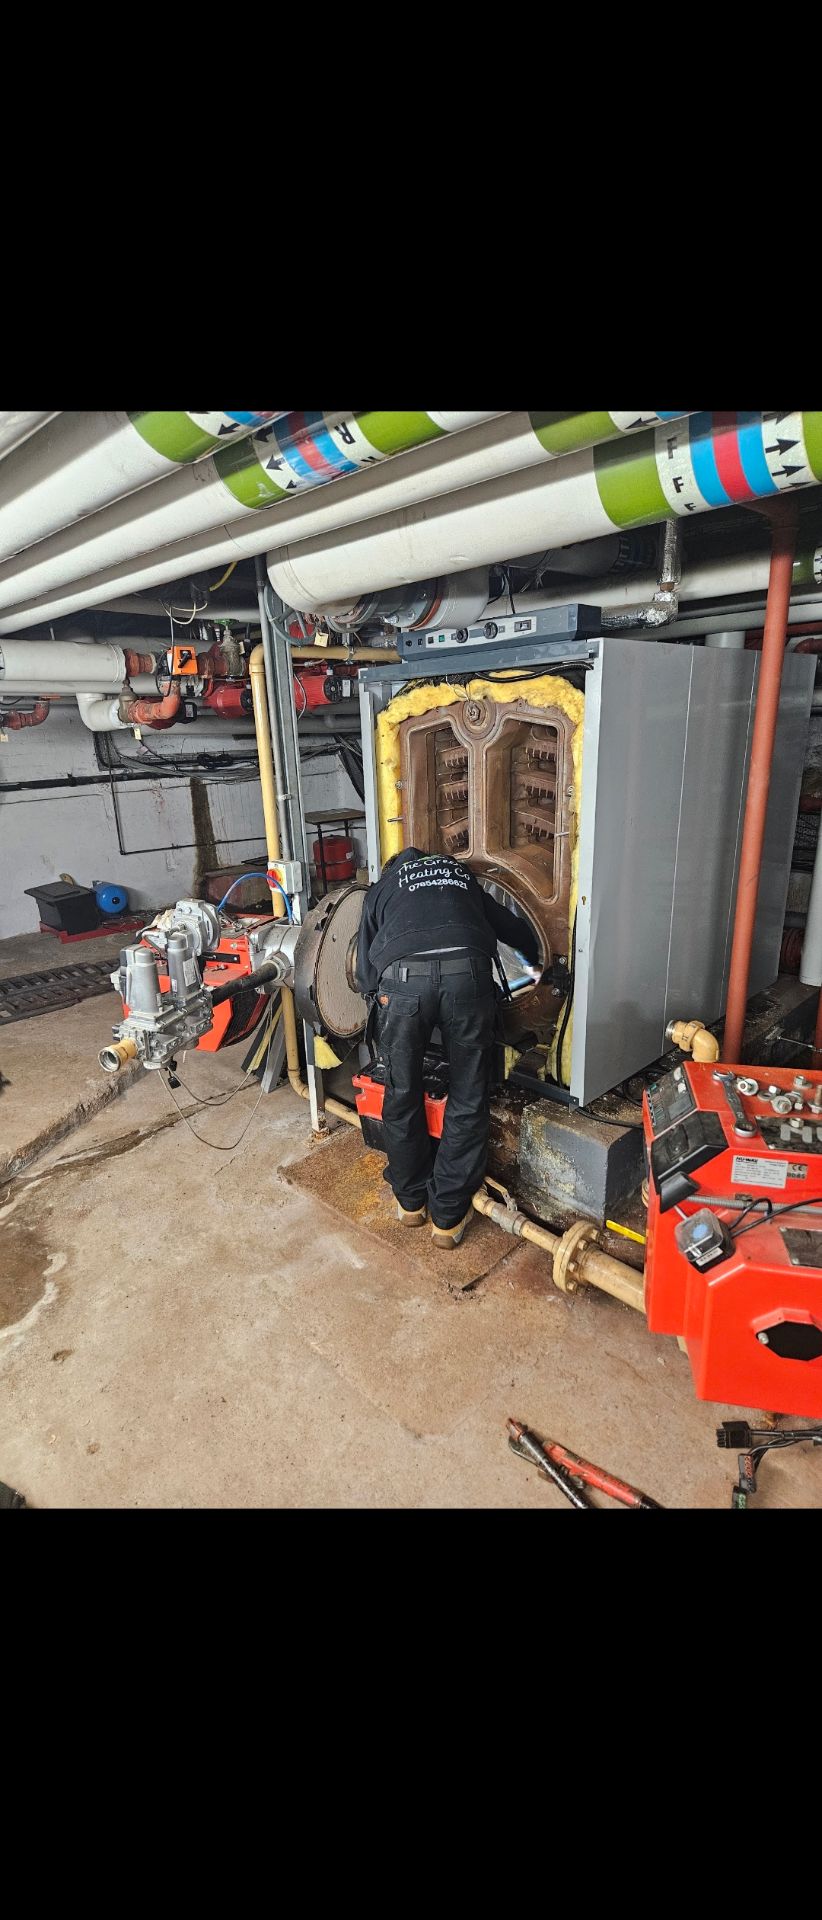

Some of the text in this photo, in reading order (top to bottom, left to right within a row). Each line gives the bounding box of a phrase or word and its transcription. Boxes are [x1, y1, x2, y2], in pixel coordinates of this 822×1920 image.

[334, 421, 356, 445] R
[667, 436, 678, 459] F
[672, 476, 685, 493] F
[399, 867, 470, 888] Heating Co
